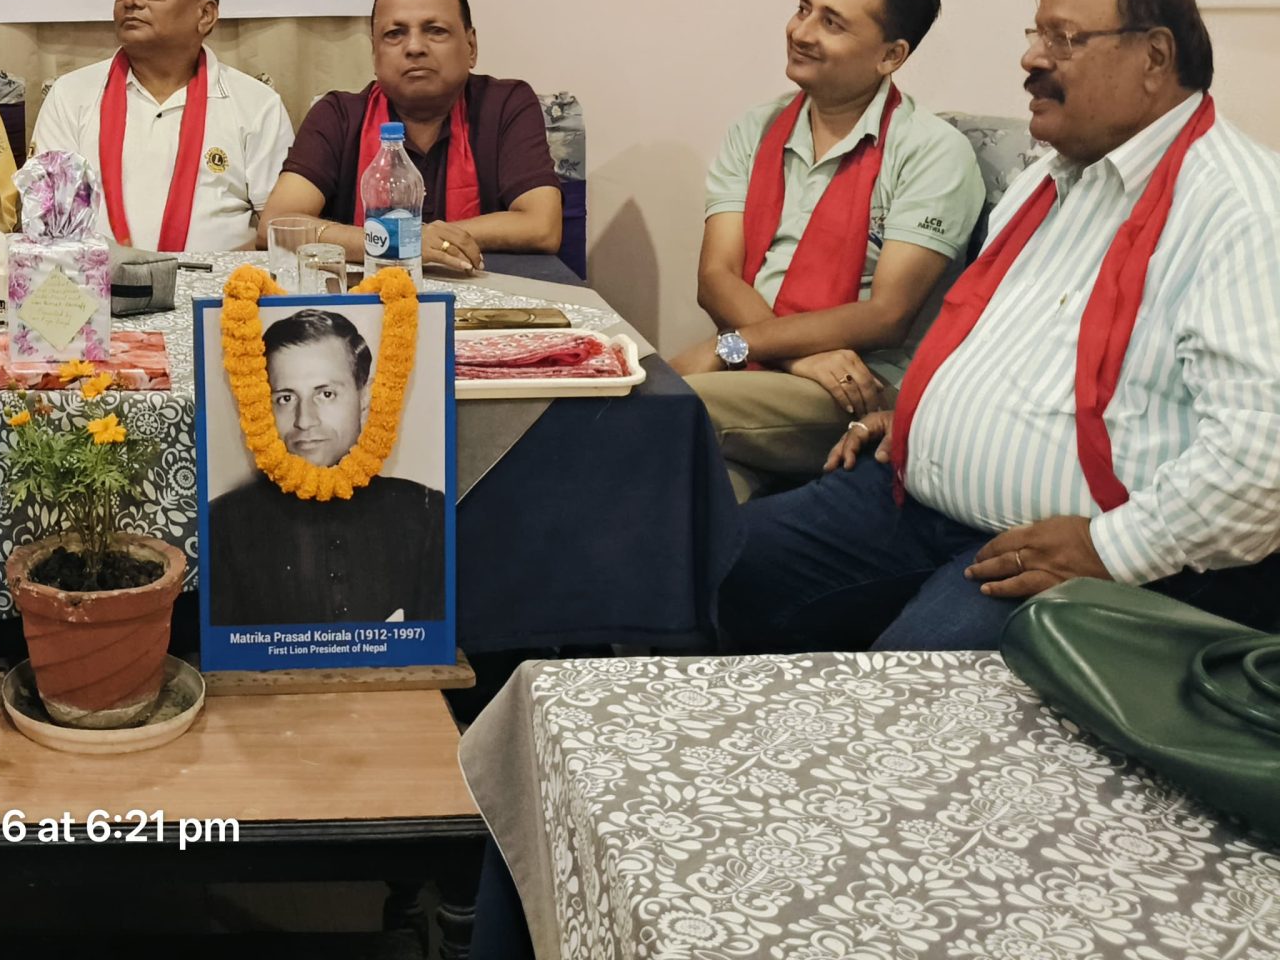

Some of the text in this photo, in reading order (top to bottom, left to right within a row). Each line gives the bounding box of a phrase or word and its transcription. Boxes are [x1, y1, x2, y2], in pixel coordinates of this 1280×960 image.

[925, 216, 942, 227] LCB
[366, 232, 387, 248] nley
[230, 628, 425, 644] Matrika Prasad Koirala (1912-1997)
[268, 643, 386, 655] First Lion President of Nepal
